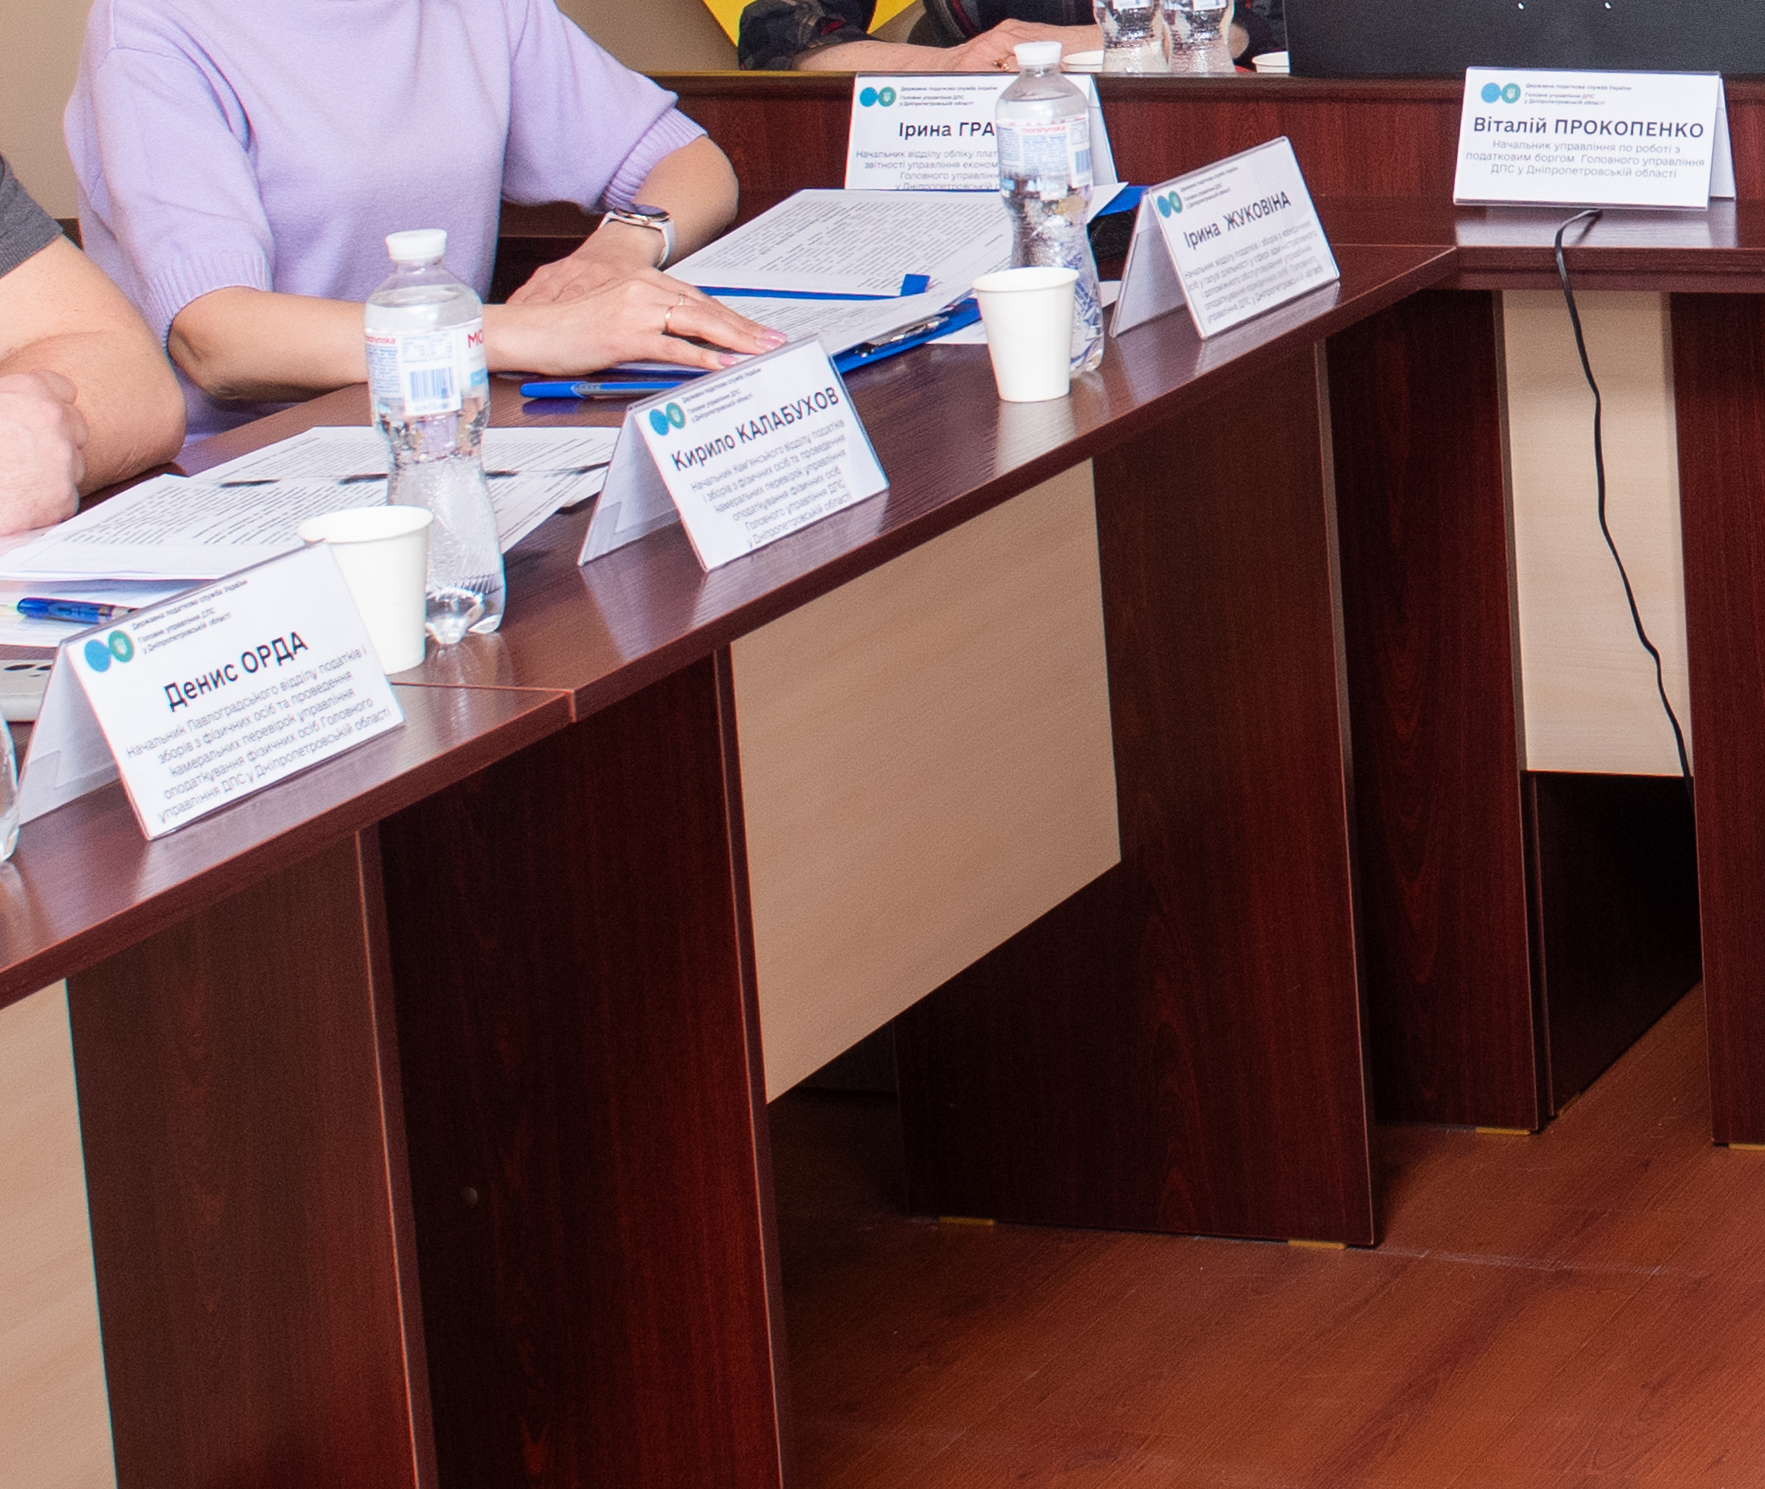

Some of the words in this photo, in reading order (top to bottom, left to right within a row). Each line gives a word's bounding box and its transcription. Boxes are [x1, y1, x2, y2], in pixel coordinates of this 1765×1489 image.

[899, 122, 951, 140] Ірина
[1474, 116, 1546, 134] Віталій
[1555, 119, 1704, 138] ПРОКОПЕНКО
[856, 150, 905, 159] Начальник
[908, 150, 941, 160] відділу
[944, 150, 973, 160] обліку
[1492, 140, 1551, 150] Начальник
[1554, 142, 1615, 152] управління
[1619, 144, 1633, 152] по
[1636, 144, 1672, 155] роботі
[908, 161, 960, 170] управління
[1466, 152, 1532, 162] податковим
[1535, 153, 1575, 164] боргом
[1581, 154, 1639, 165] Головного
[1642, 156, 1704, 168] управління
[900, 172, 949, 180] Головного
[951, 172, 999, 181] управлінн
[1491, 165, 1514, 175] ДПС
[1526, 165, 1632, 177] Дніпропетровській
[1635, 168, 1676, 178] області
[1183, 222, 1221, 250] Ірина
[1223, 191, 1291, 230] ЖУКОВІНА
[671, 434, 735, 471] Кирило
[736, 386, 838, 442] КАЛАБУХОВ
[164, 663, 238, 712] Денис
[240, 631, 307, 673] ОРДА
